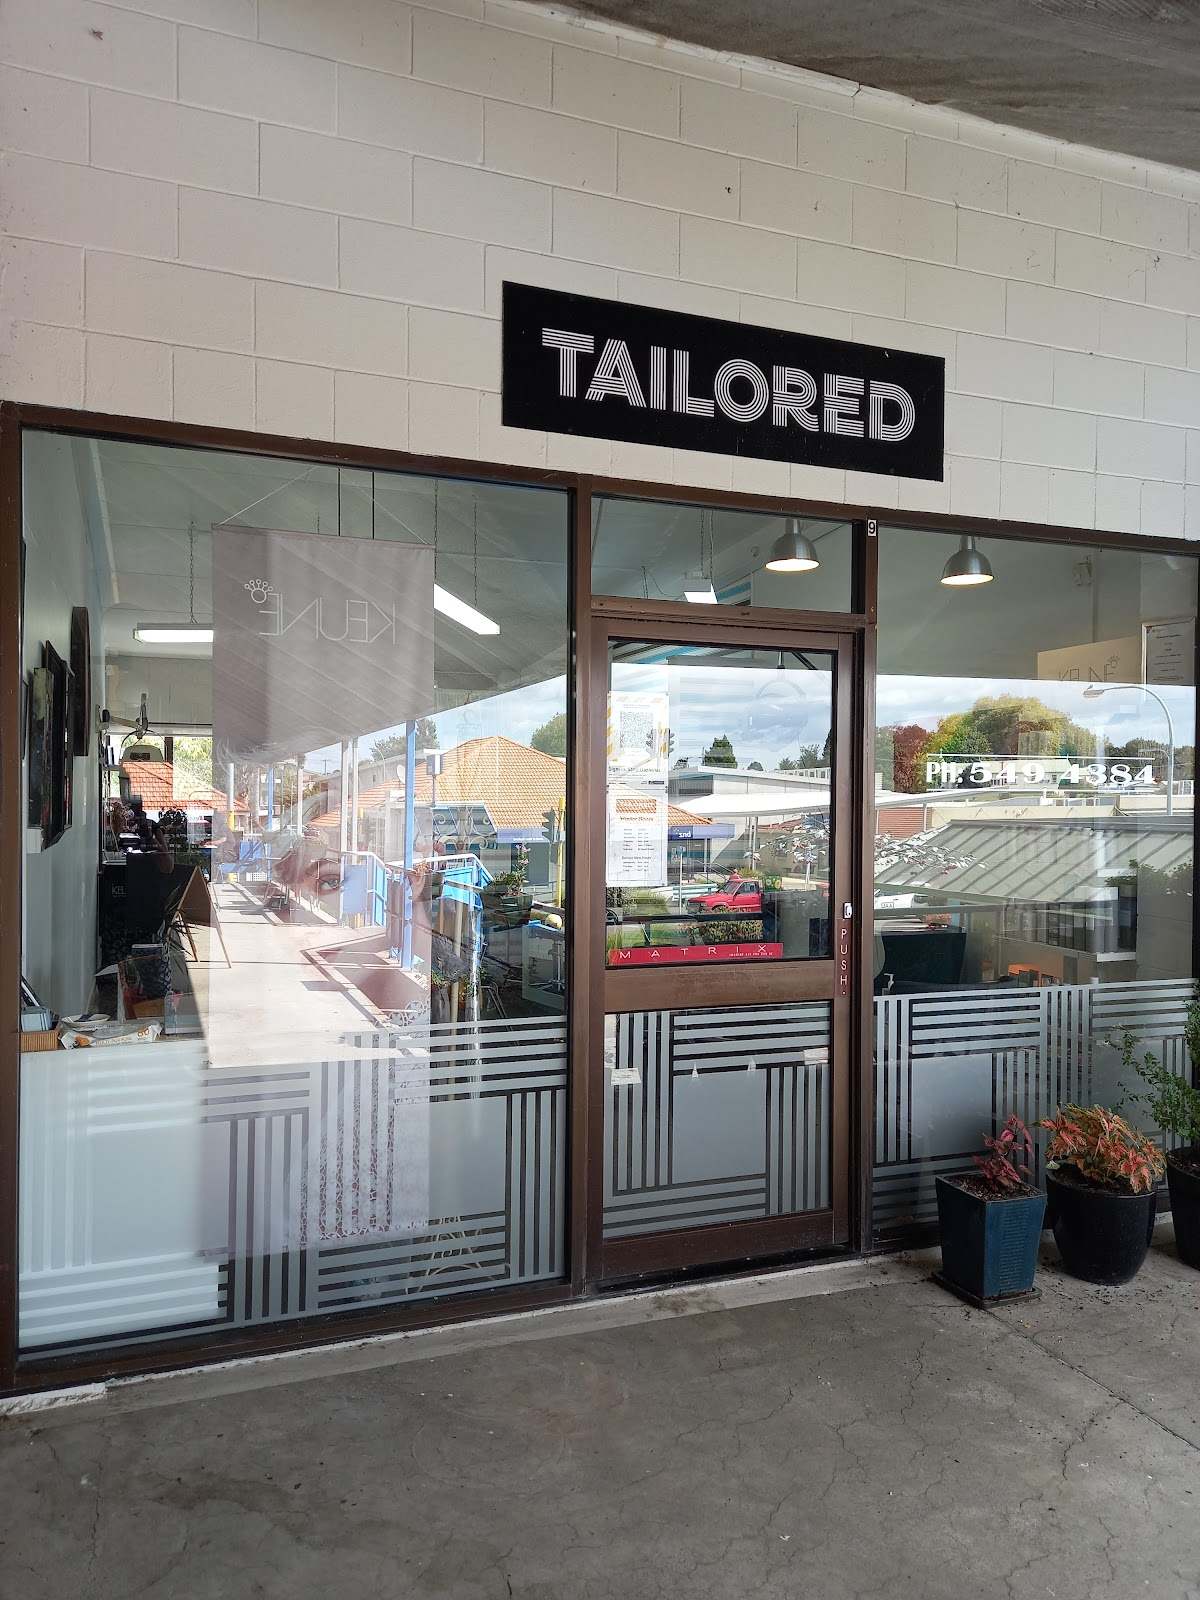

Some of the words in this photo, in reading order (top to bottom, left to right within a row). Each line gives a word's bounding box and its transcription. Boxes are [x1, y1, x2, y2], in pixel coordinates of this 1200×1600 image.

[542, 327, 915, 442] TAILORED
[868, 521, 876, 535] 9
[619, 944, 767, 959] MATRIX
[840, 928, 848, 986] PUSH
